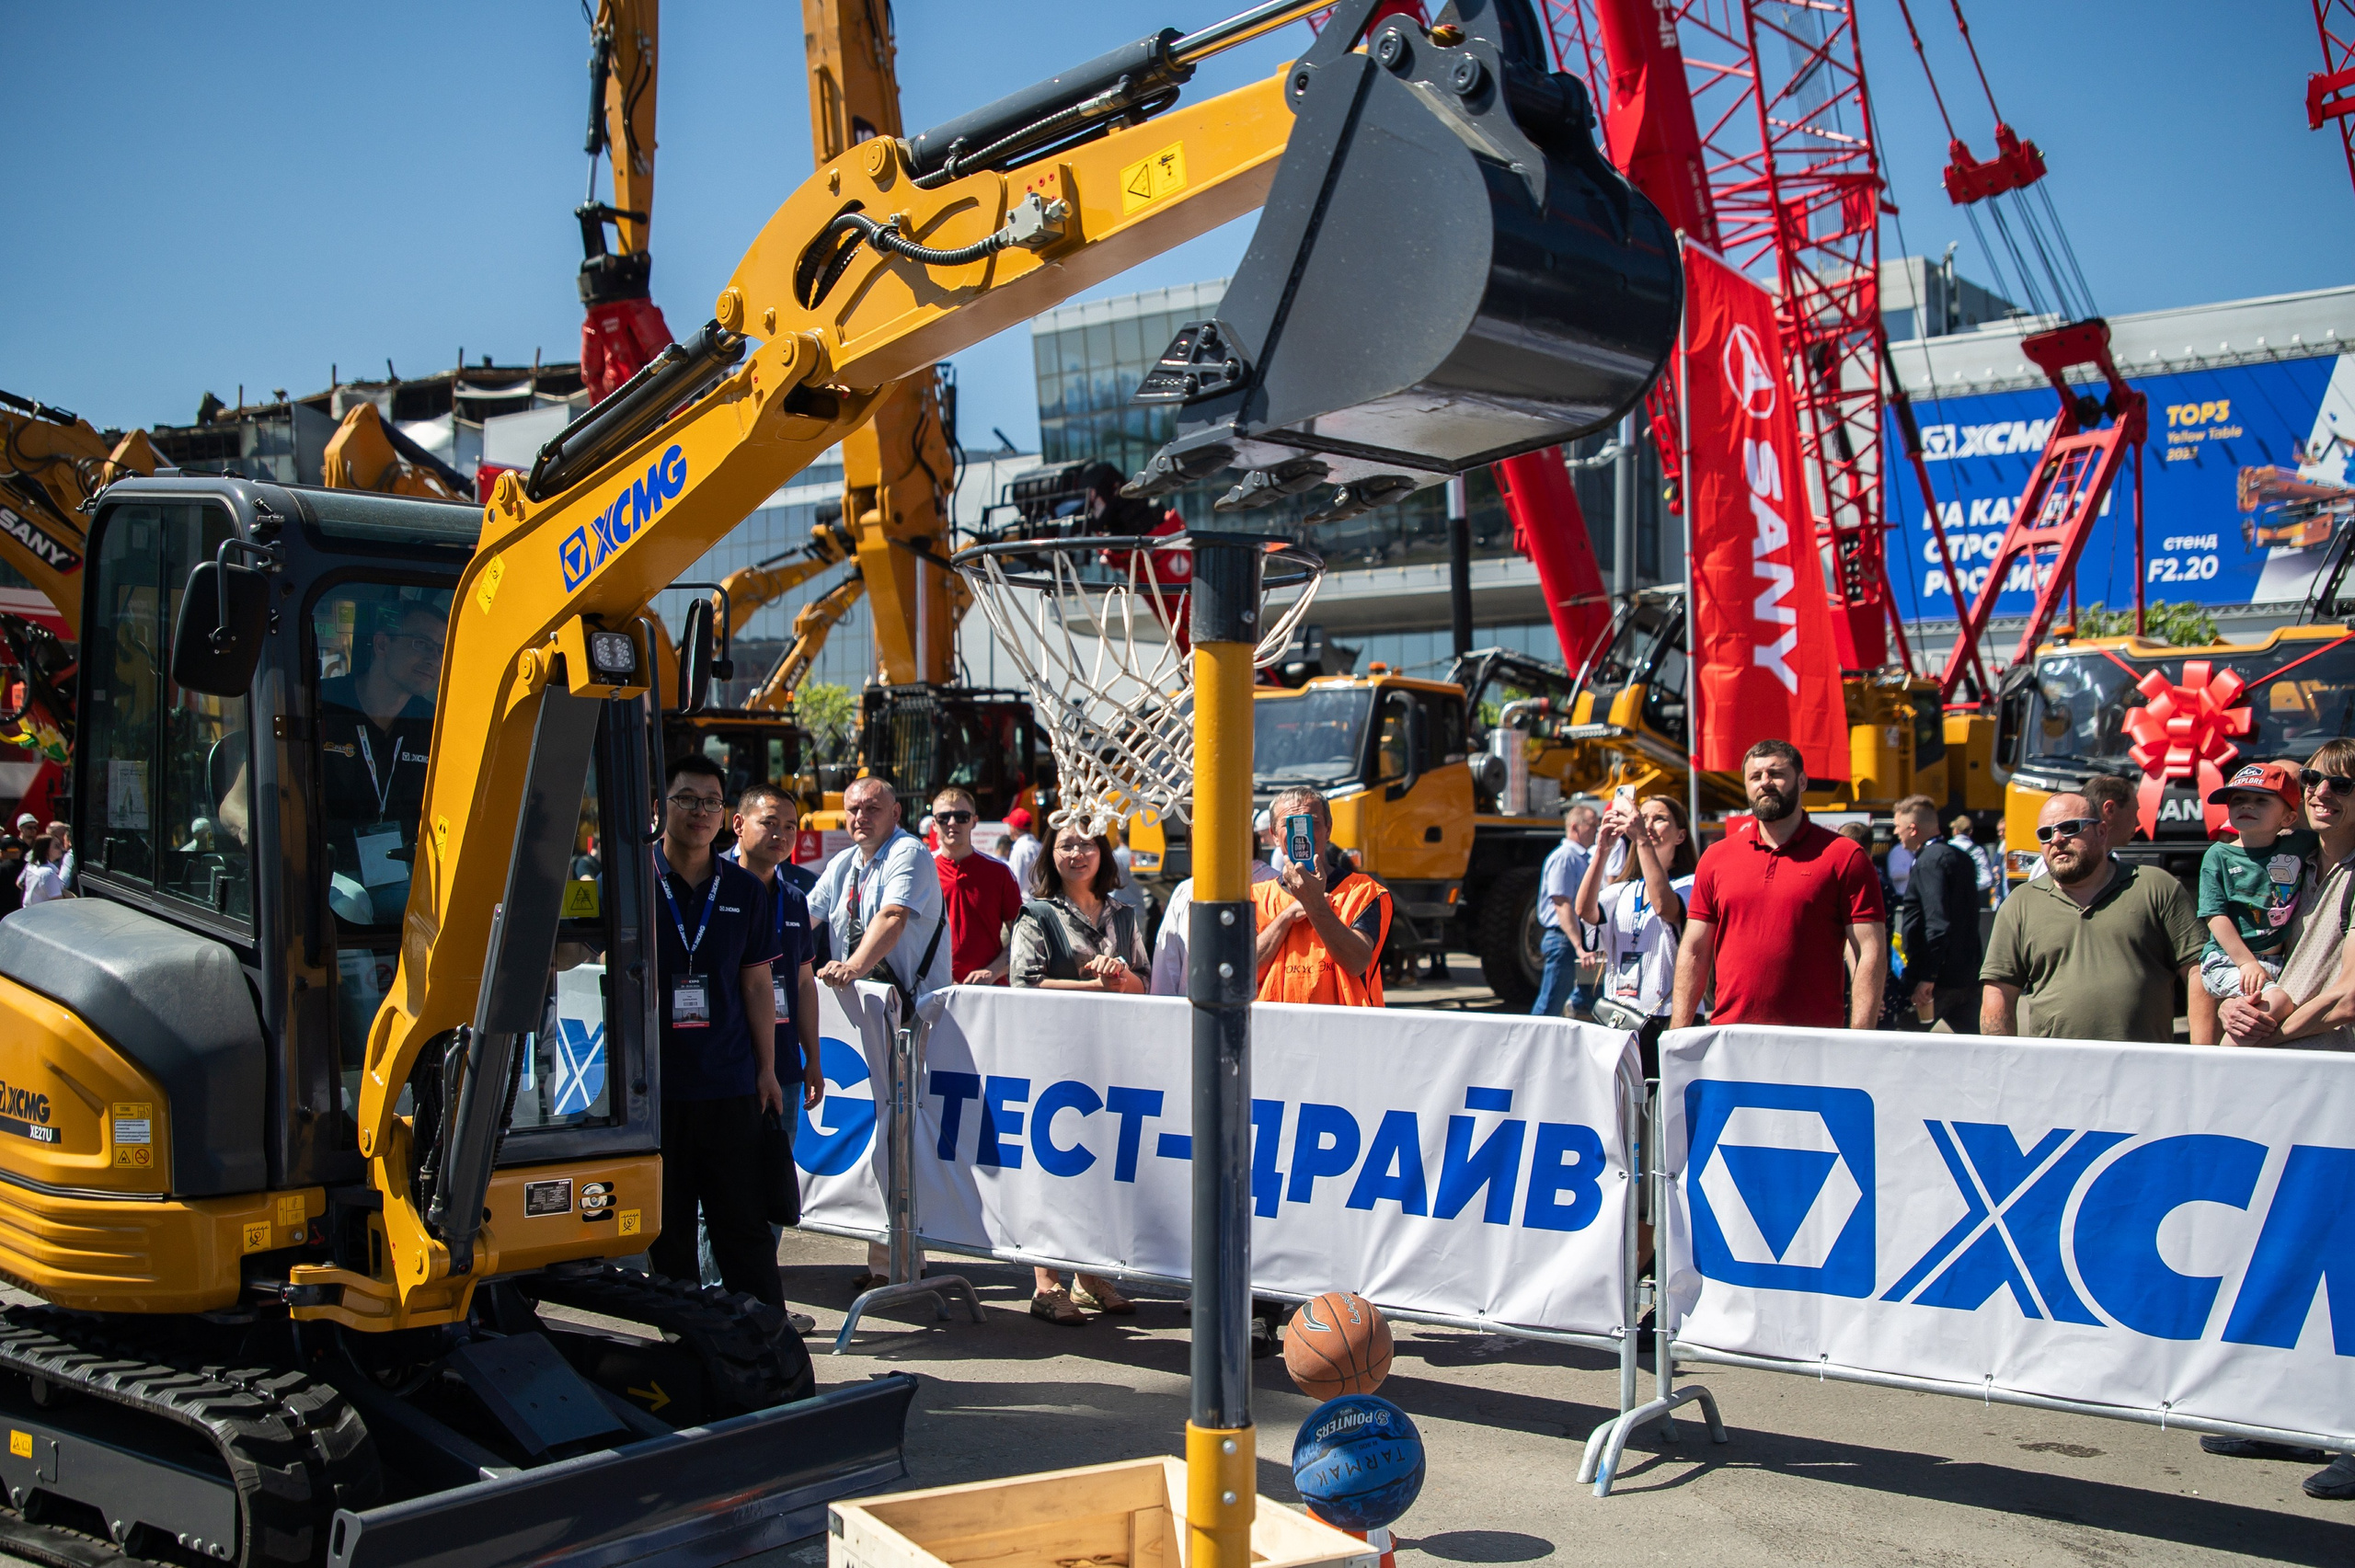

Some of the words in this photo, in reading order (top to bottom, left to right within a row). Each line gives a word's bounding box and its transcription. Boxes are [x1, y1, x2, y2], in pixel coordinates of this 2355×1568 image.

[2166, 399, 2231, 428] TOP3
[2209, 425, 2243, 441] Table
[591, 444, 687, 571] XCMG
[0, 508, 69, 566] SANY
[2163, 533, 2218, 552] стенд
[1743, 438, 1798, 695] SANY
[2147, 555, 2220, 583] F2.20
[712, 876, 720, 894] XCMG
[695, 925, 706, 944] XCMG
[1285, 965, 1315, 974] ОКУС
[7, 1086, 52, 1124] XCMG
[29, 1125, 53, 1142] XE27U
[1315, 1412, 1373, 1443] POINTERS
[1315, 1447, 1406, 1487] TARMAK
